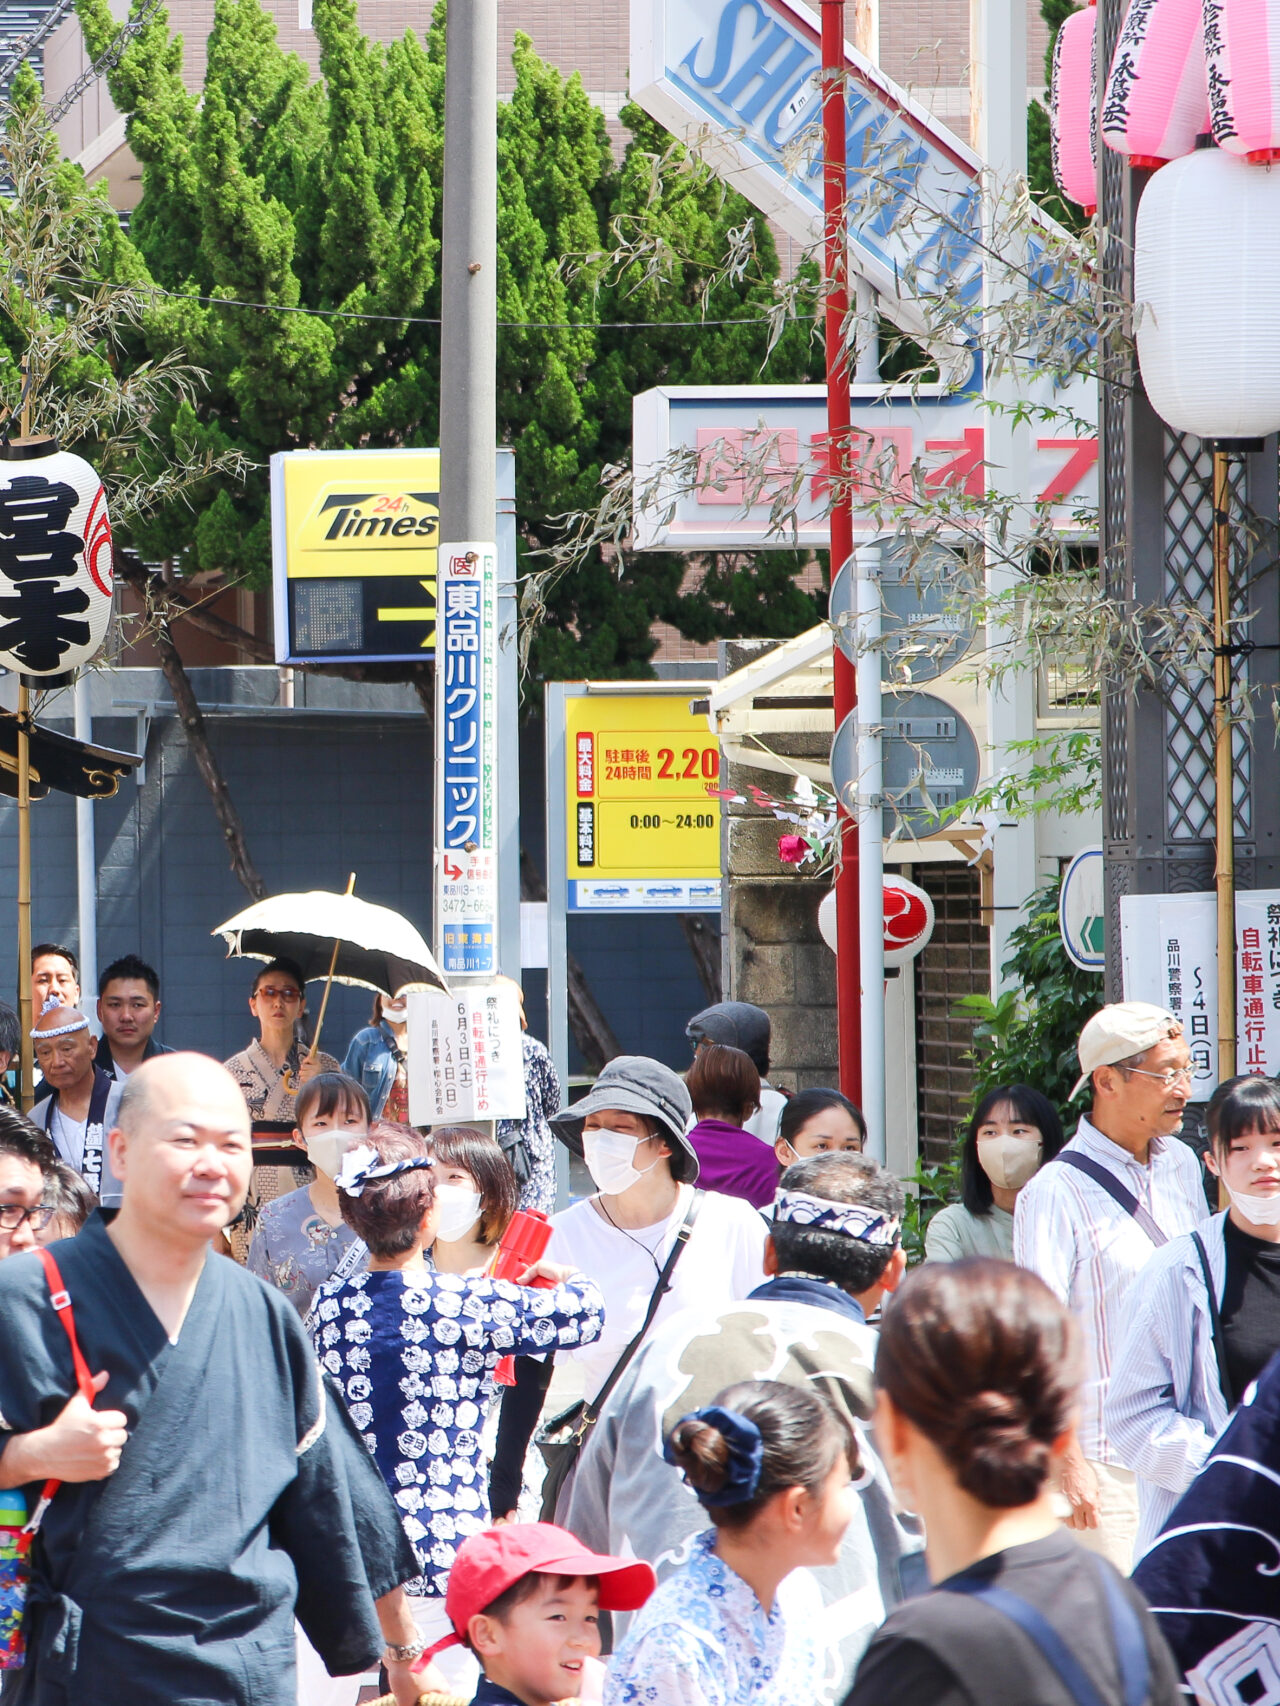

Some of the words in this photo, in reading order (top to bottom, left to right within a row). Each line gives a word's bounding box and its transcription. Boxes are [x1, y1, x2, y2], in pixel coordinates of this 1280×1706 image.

[324, 508, 439, 540] Times
[372, 496, 410, 513] 24h
[446, 583, 480, 847] 東品川クリニック
[578, 737, 593, 792] 最大料金
[605, 749, 650, 763] 駐車後
[605, 766, 652, 781] 24時間
[578, 807, 593, 863] 基本料金
[486, 996, 501, 1063] 祭礼につき
[472, 1011, 489, 1111] 自転車通行止め
